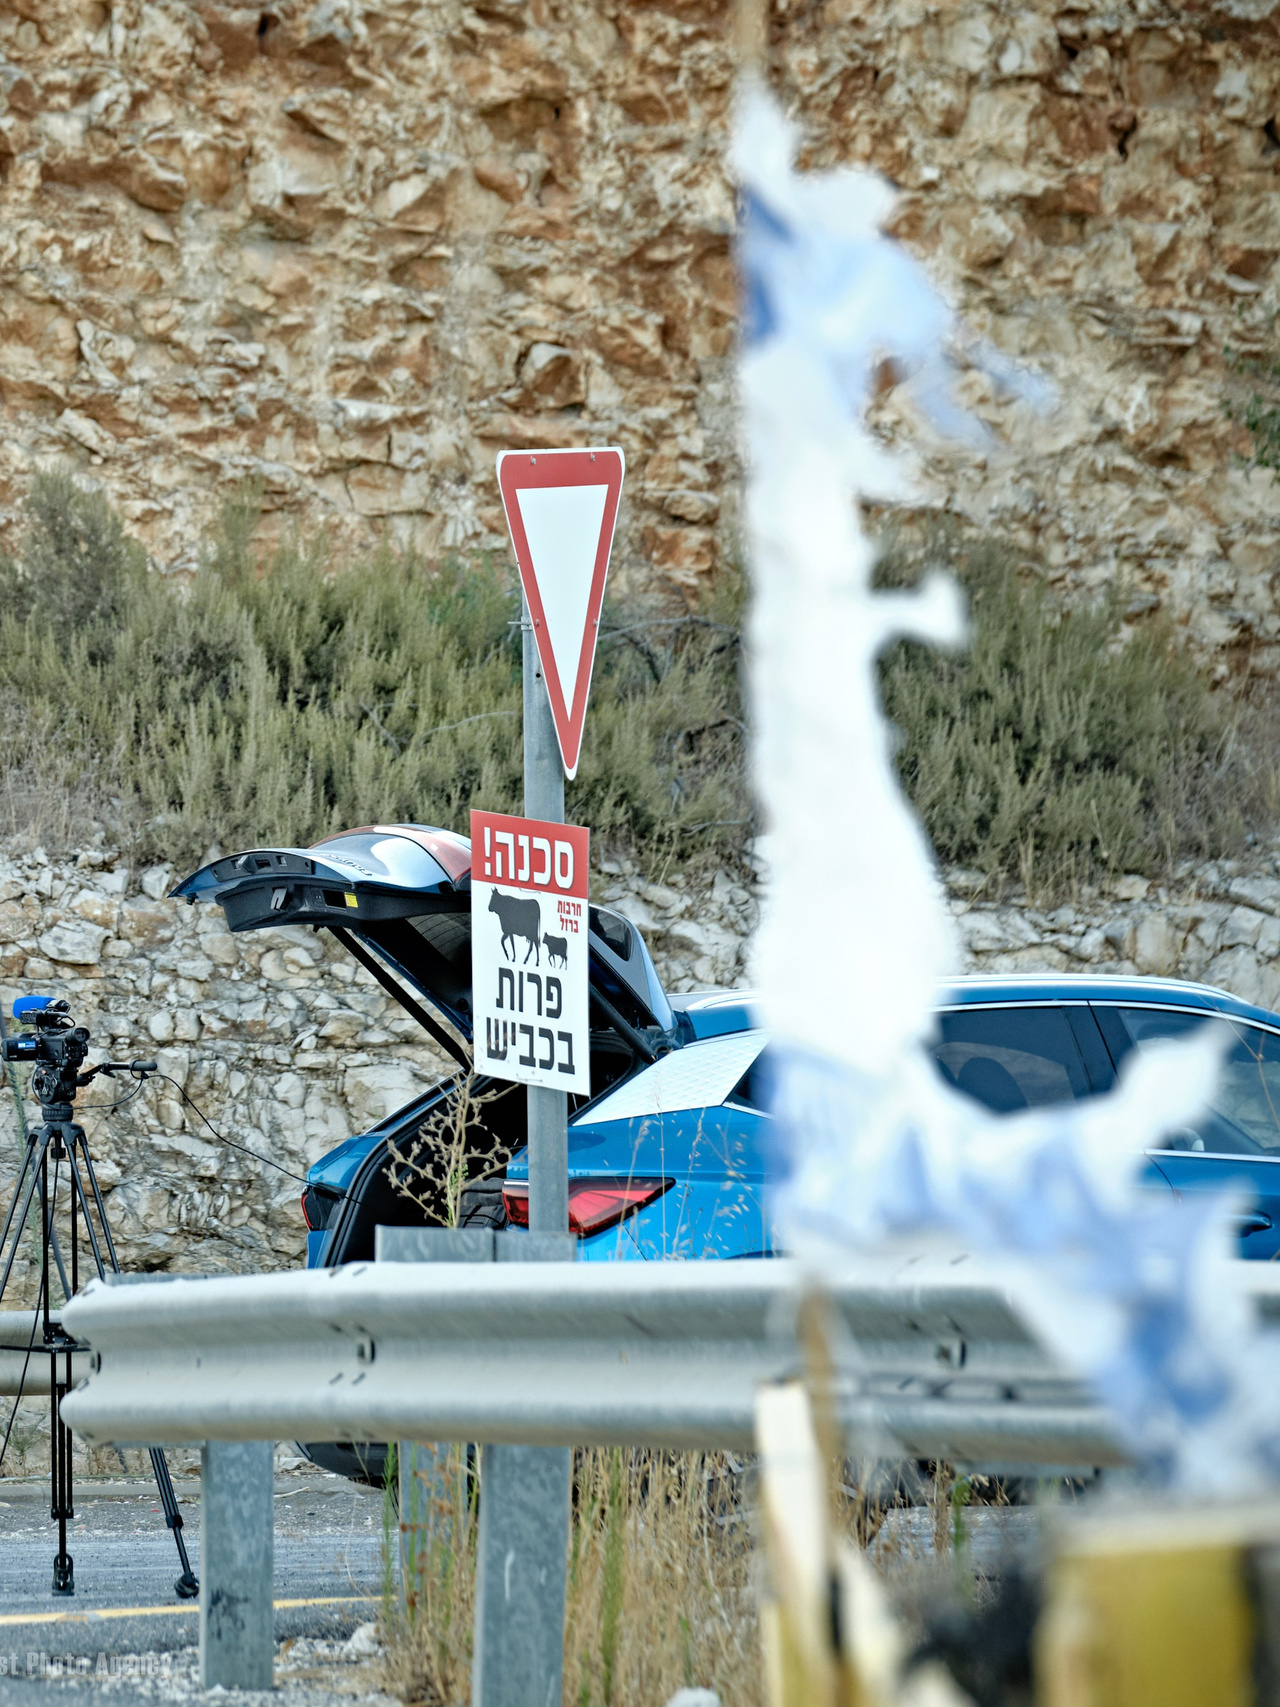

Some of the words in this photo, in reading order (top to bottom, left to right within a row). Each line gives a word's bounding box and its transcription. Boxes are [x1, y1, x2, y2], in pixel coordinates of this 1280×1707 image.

[483, 827, 574, 889] סכנה!
[557, 900, 582, 917] חרבות
[560, 915, 579, 933] ברזל
[496, 966, 562, 1019] פרות
[486, 1017, 575, 1075] בכביש
